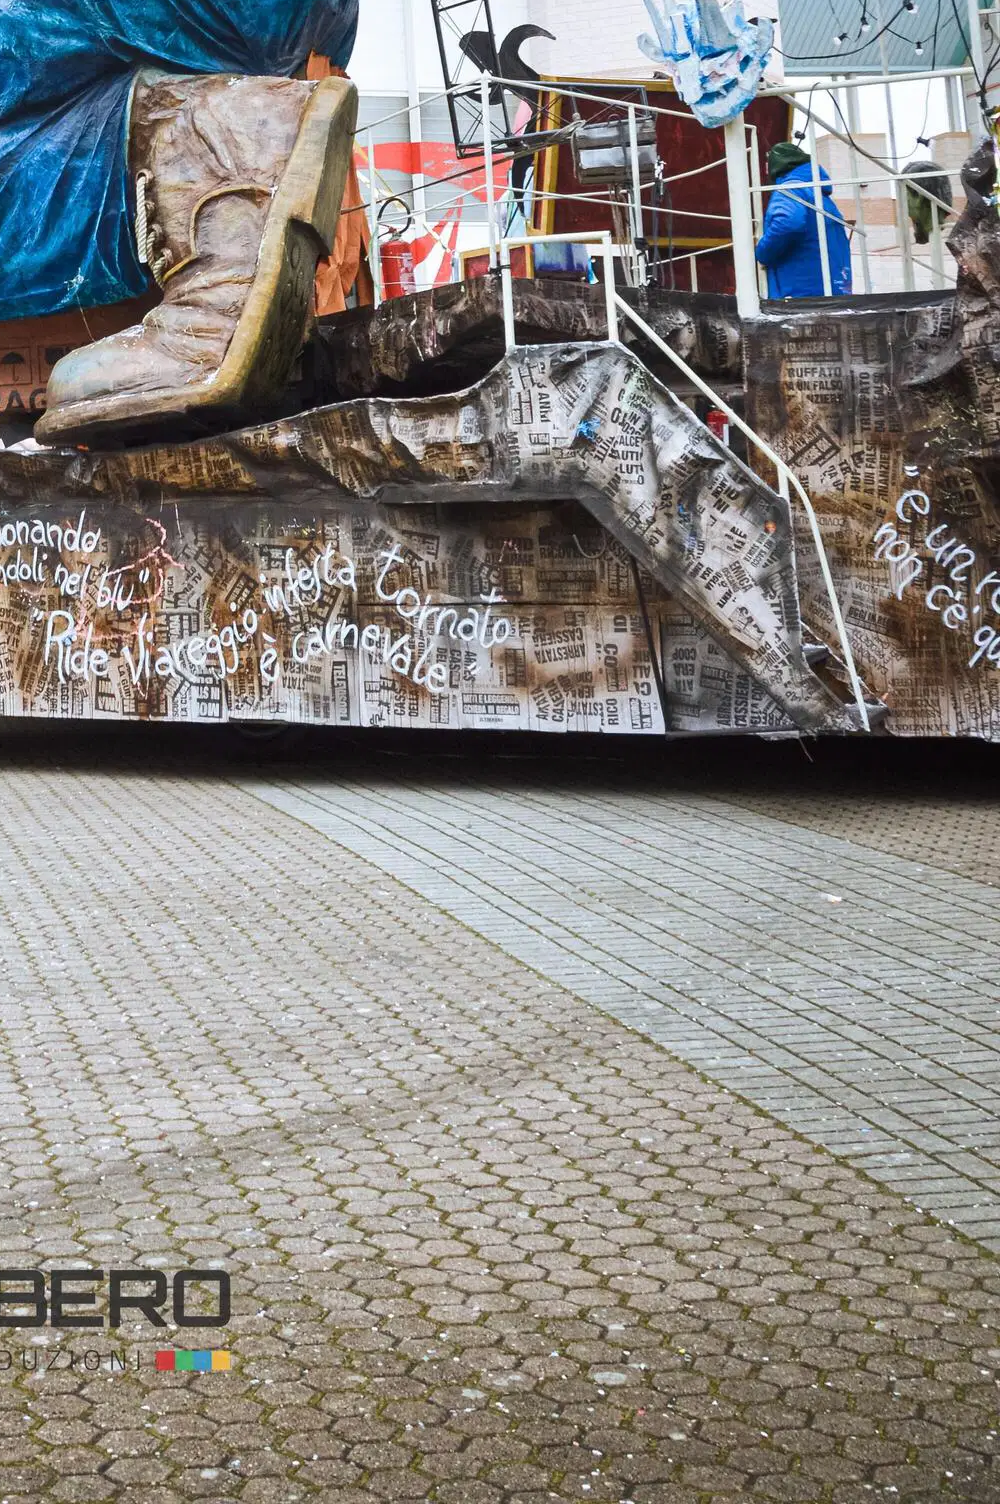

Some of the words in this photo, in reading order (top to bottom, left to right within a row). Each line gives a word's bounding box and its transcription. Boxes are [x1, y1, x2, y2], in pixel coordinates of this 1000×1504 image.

[54, 563, 92, 601] nel
[873, 521, 924, 602] non
[925, 522, 977, 583] un
[375, 543, 510, 648] tornato
[533, 642, 586, 665] ARRESTATA
